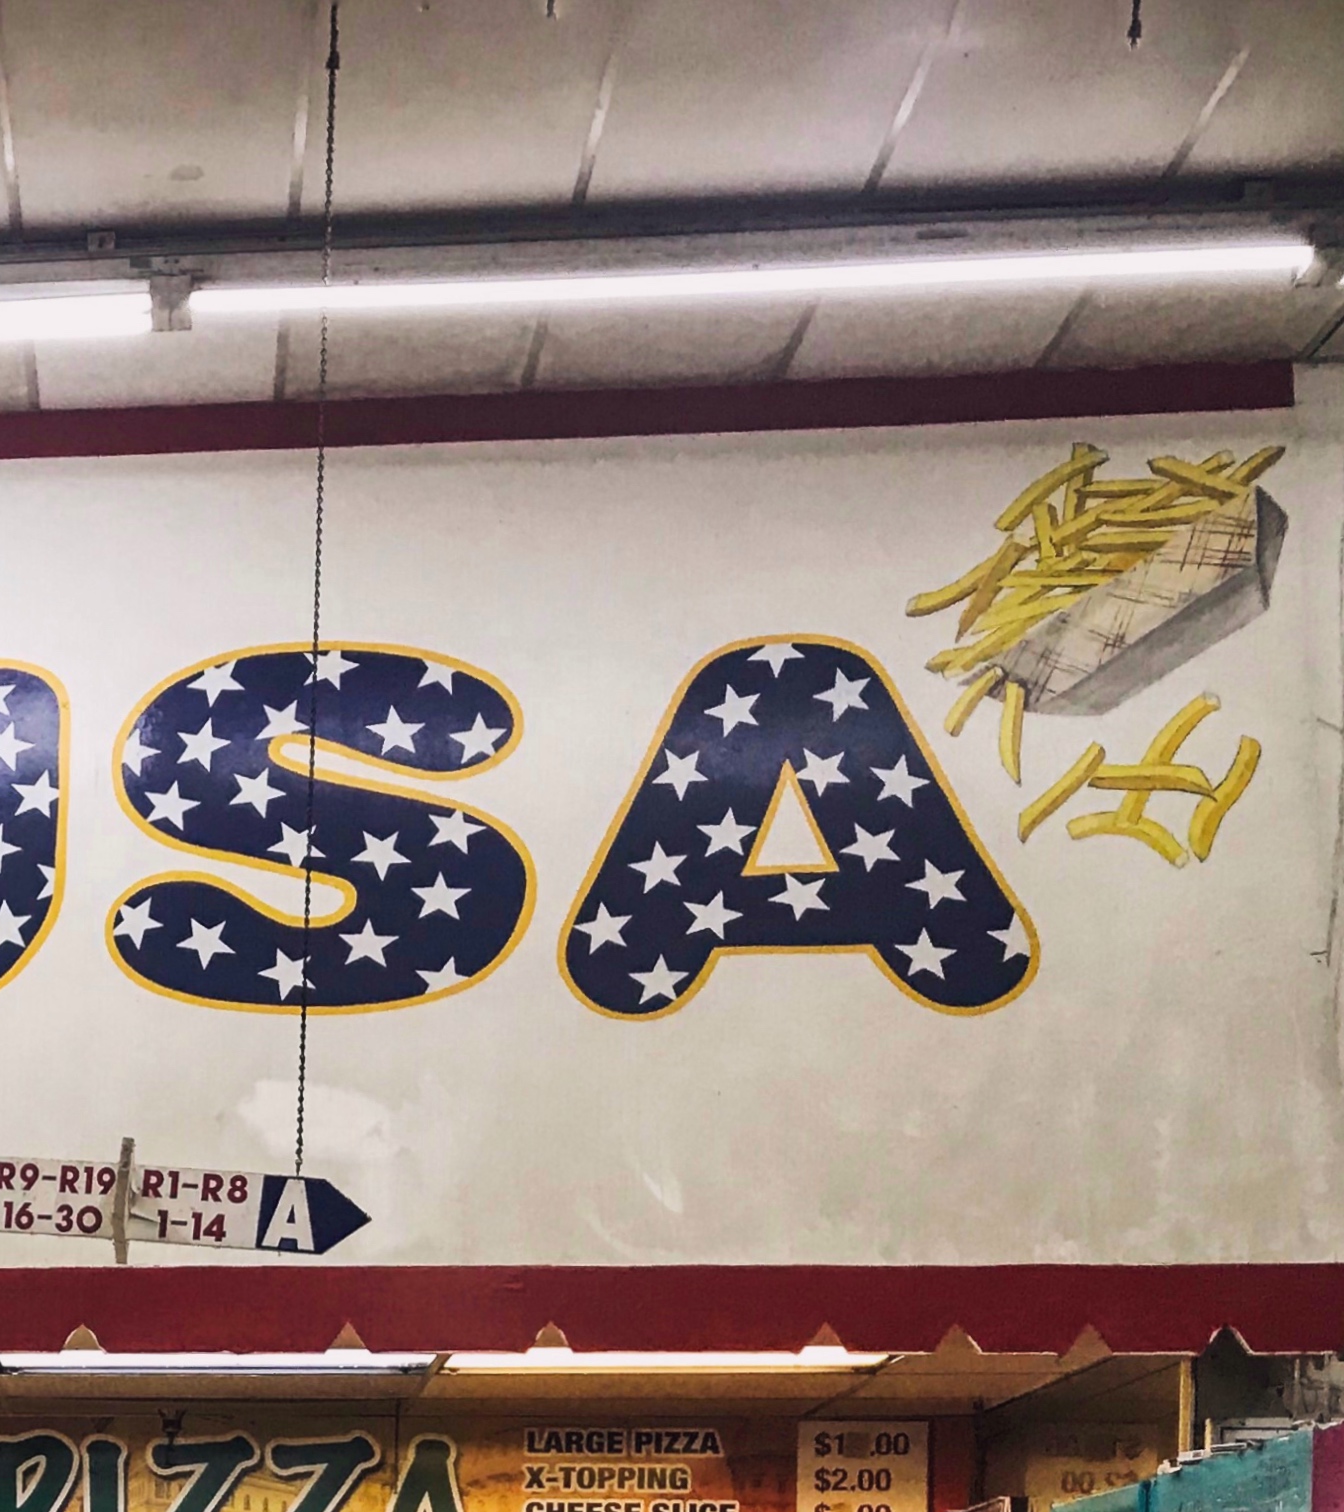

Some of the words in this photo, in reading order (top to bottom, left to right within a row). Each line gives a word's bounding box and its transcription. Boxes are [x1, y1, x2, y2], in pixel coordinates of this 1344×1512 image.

[142, 1170, 248, 1203] R1-R8
[4, 1201, 102, 1234] 16-30
[158, 1210, 226, 1242] 1-14
[261, 1179, 314, 1251] A
[526, 1430, 624, 1455] LARGE
[634, 1430, 721, 1455] PIZZA
[814, 1432, 910, 1457] $1.00
[525, 1465, 690, 1490] X-TOPPING
[814, 1468, 892, 1493] $2.00
